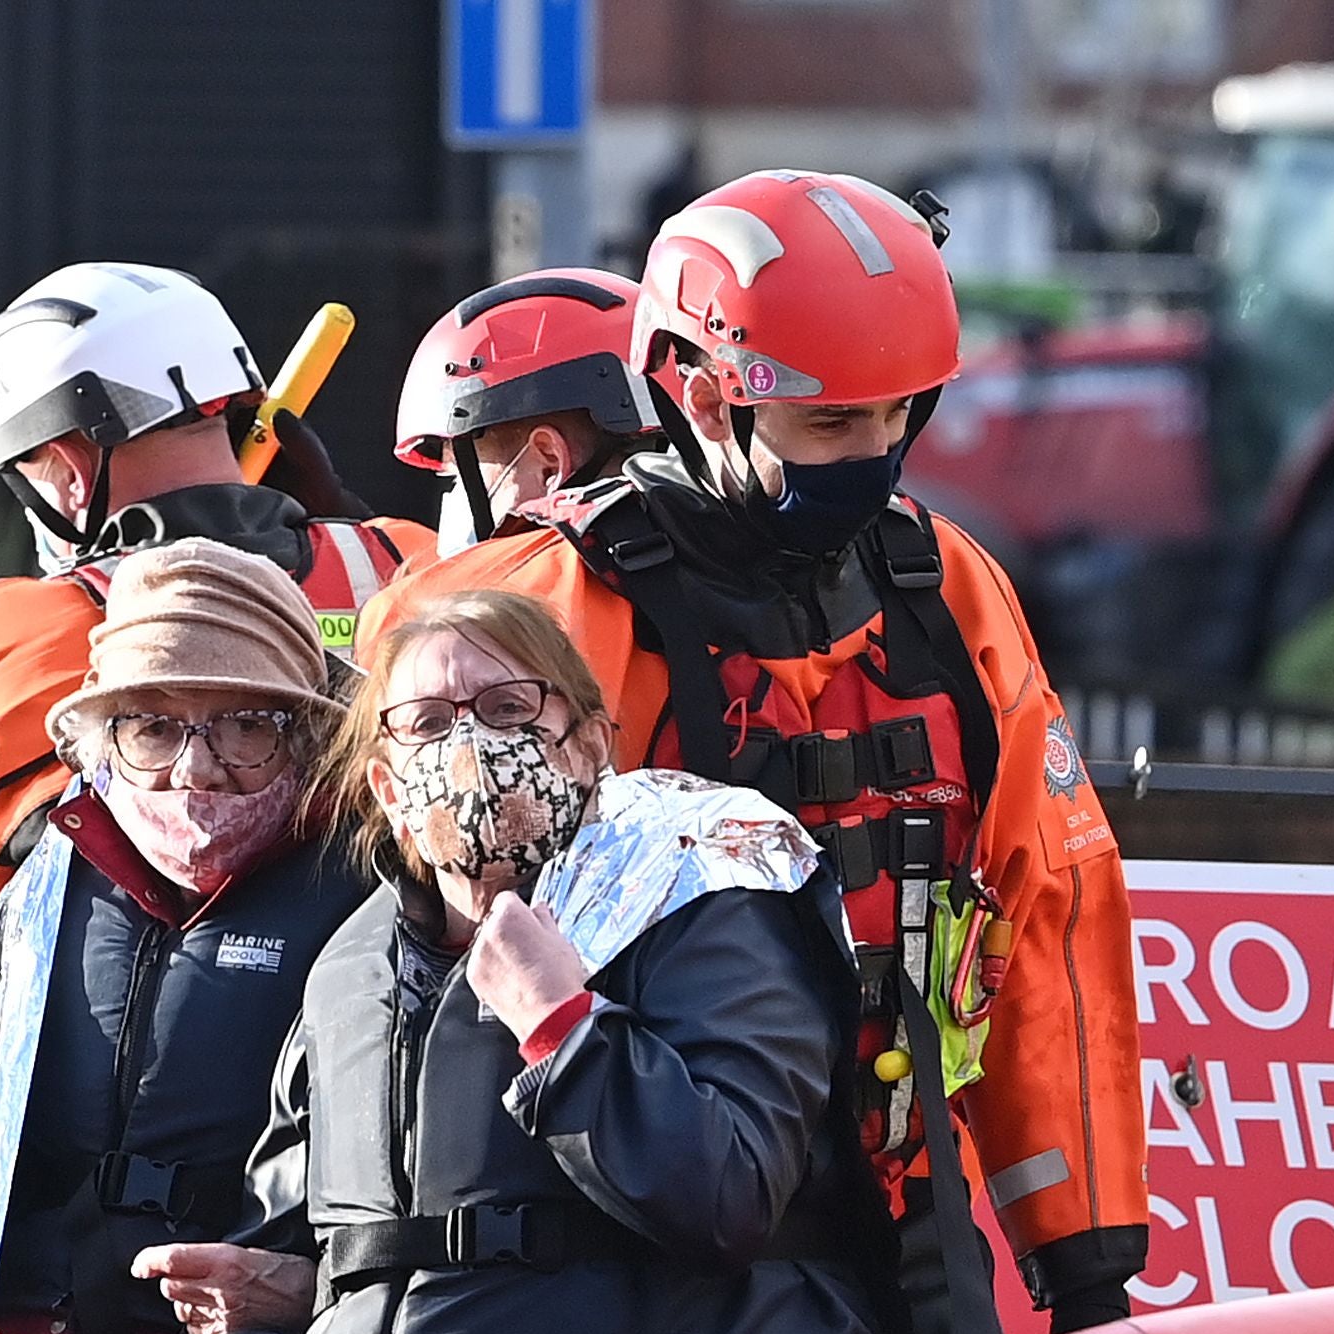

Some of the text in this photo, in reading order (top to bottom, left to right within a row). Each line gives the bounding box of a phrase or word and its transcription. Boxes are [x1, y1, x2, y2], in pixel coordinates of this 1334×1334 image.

[754, 378, 768, 389] 57
[221, 933, 286, 950] MARINE
[220, 949, 258, 962] POOL
